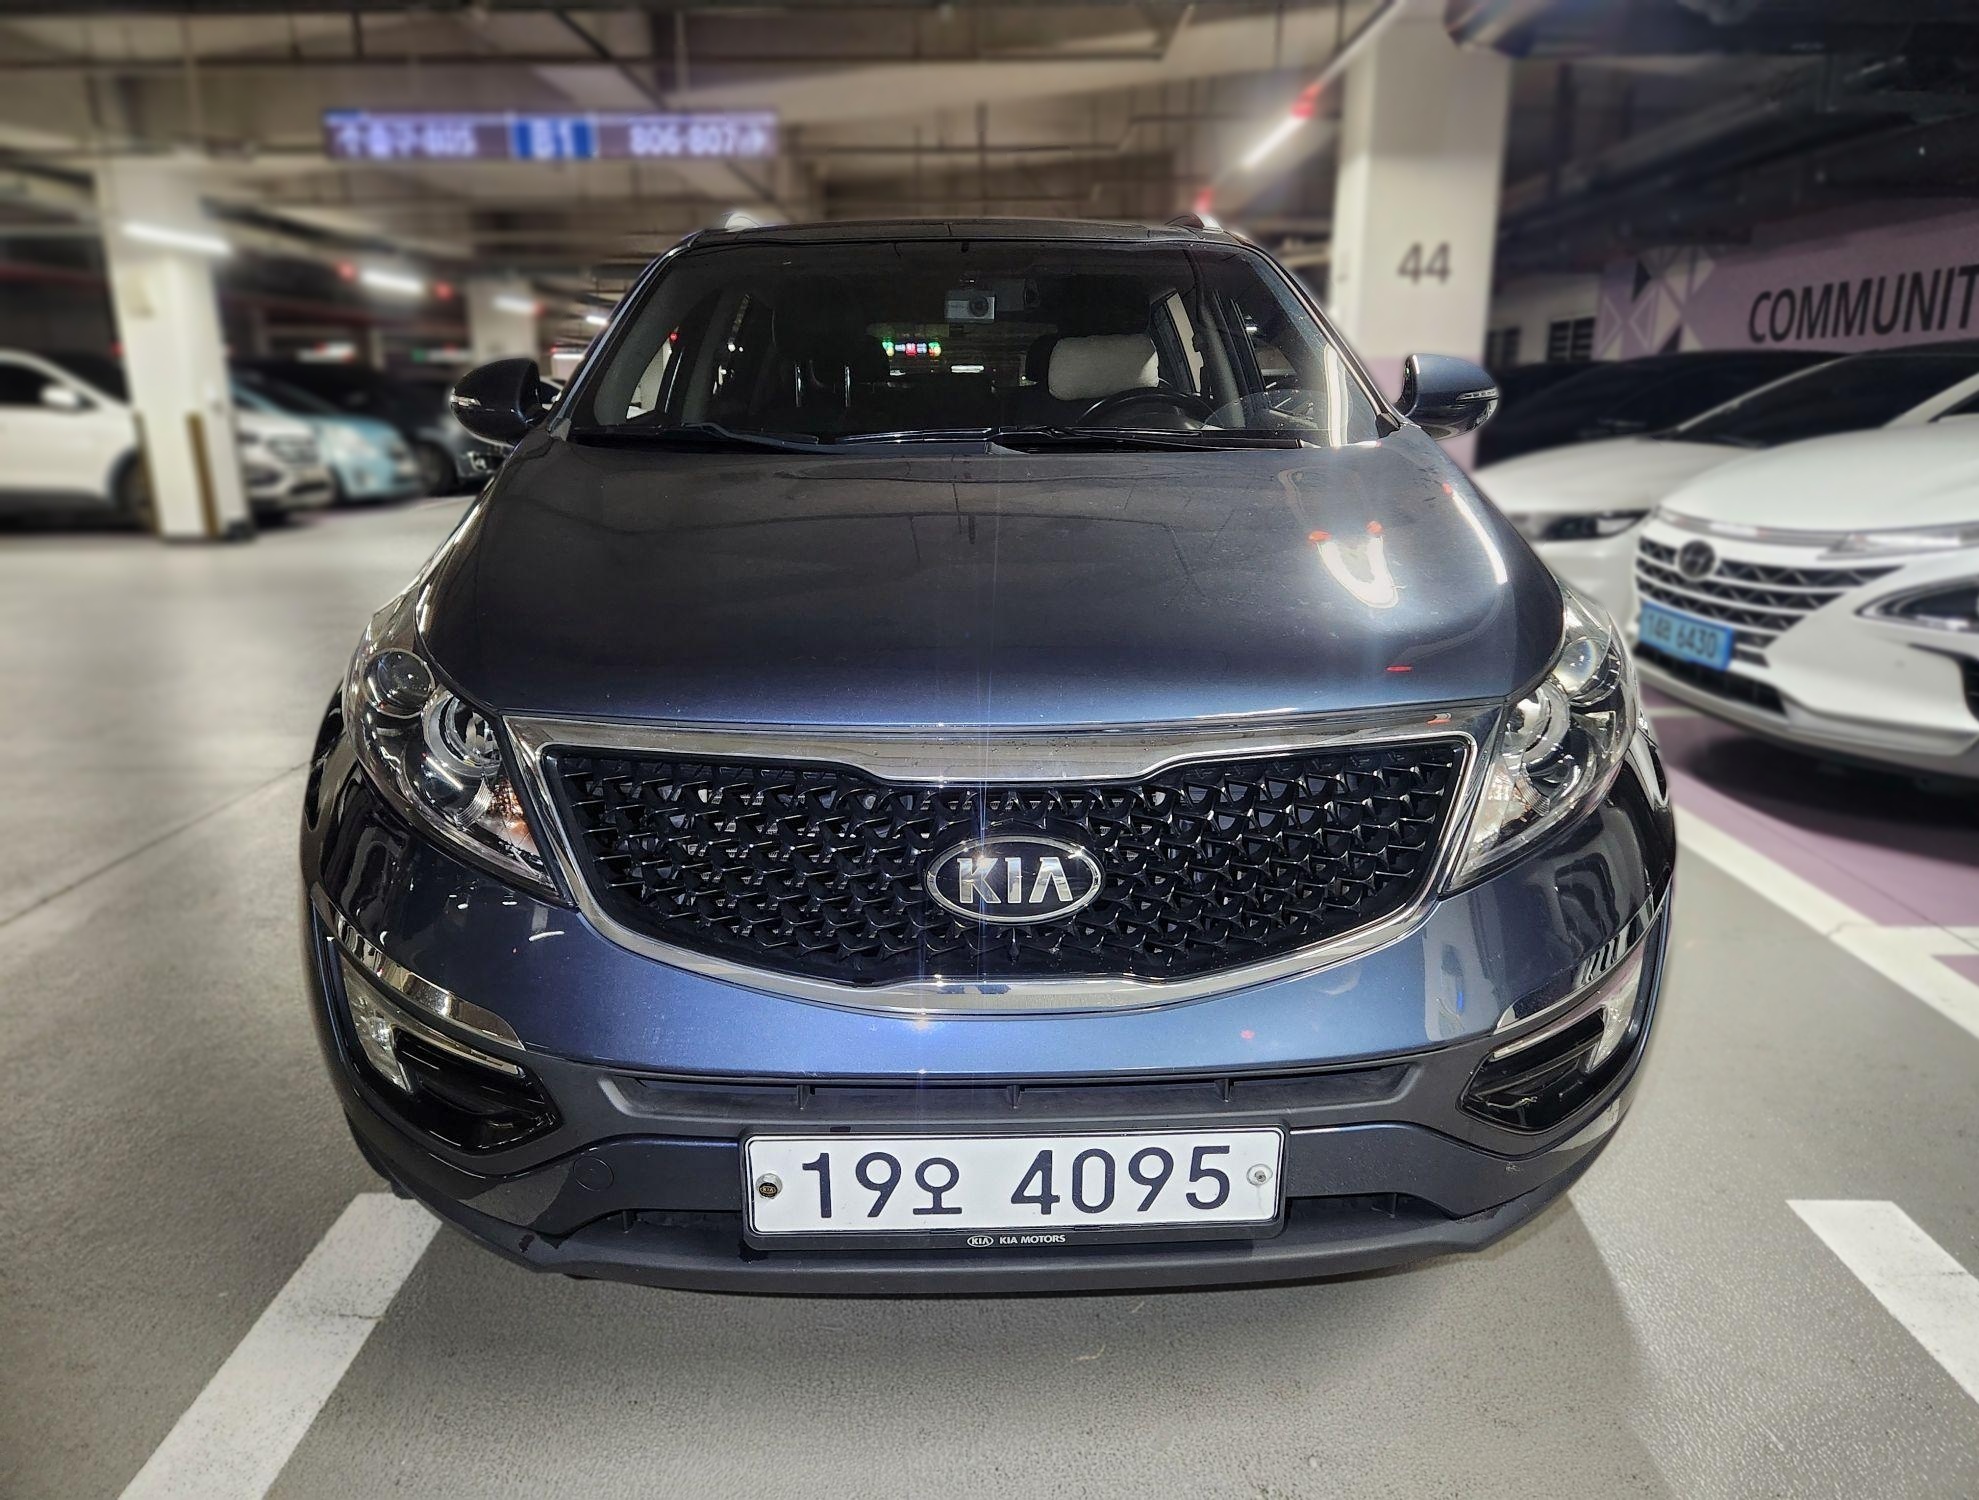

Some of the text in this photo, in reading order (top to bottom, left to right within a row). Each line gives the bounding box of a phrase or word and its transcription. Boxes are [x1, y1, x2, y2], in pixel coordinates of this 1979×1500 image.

[1396, 241, 1452, 285] 44
[1748, 263, 1979, 344] COMMUNIT
[956, 856, 1074, 904] KIA
[801, 1145, 1231, 1219] 19오 4095
[999, 1236, 1018, 1245] KIA
[1020, 1234, 1066, 1244] MOTORS
